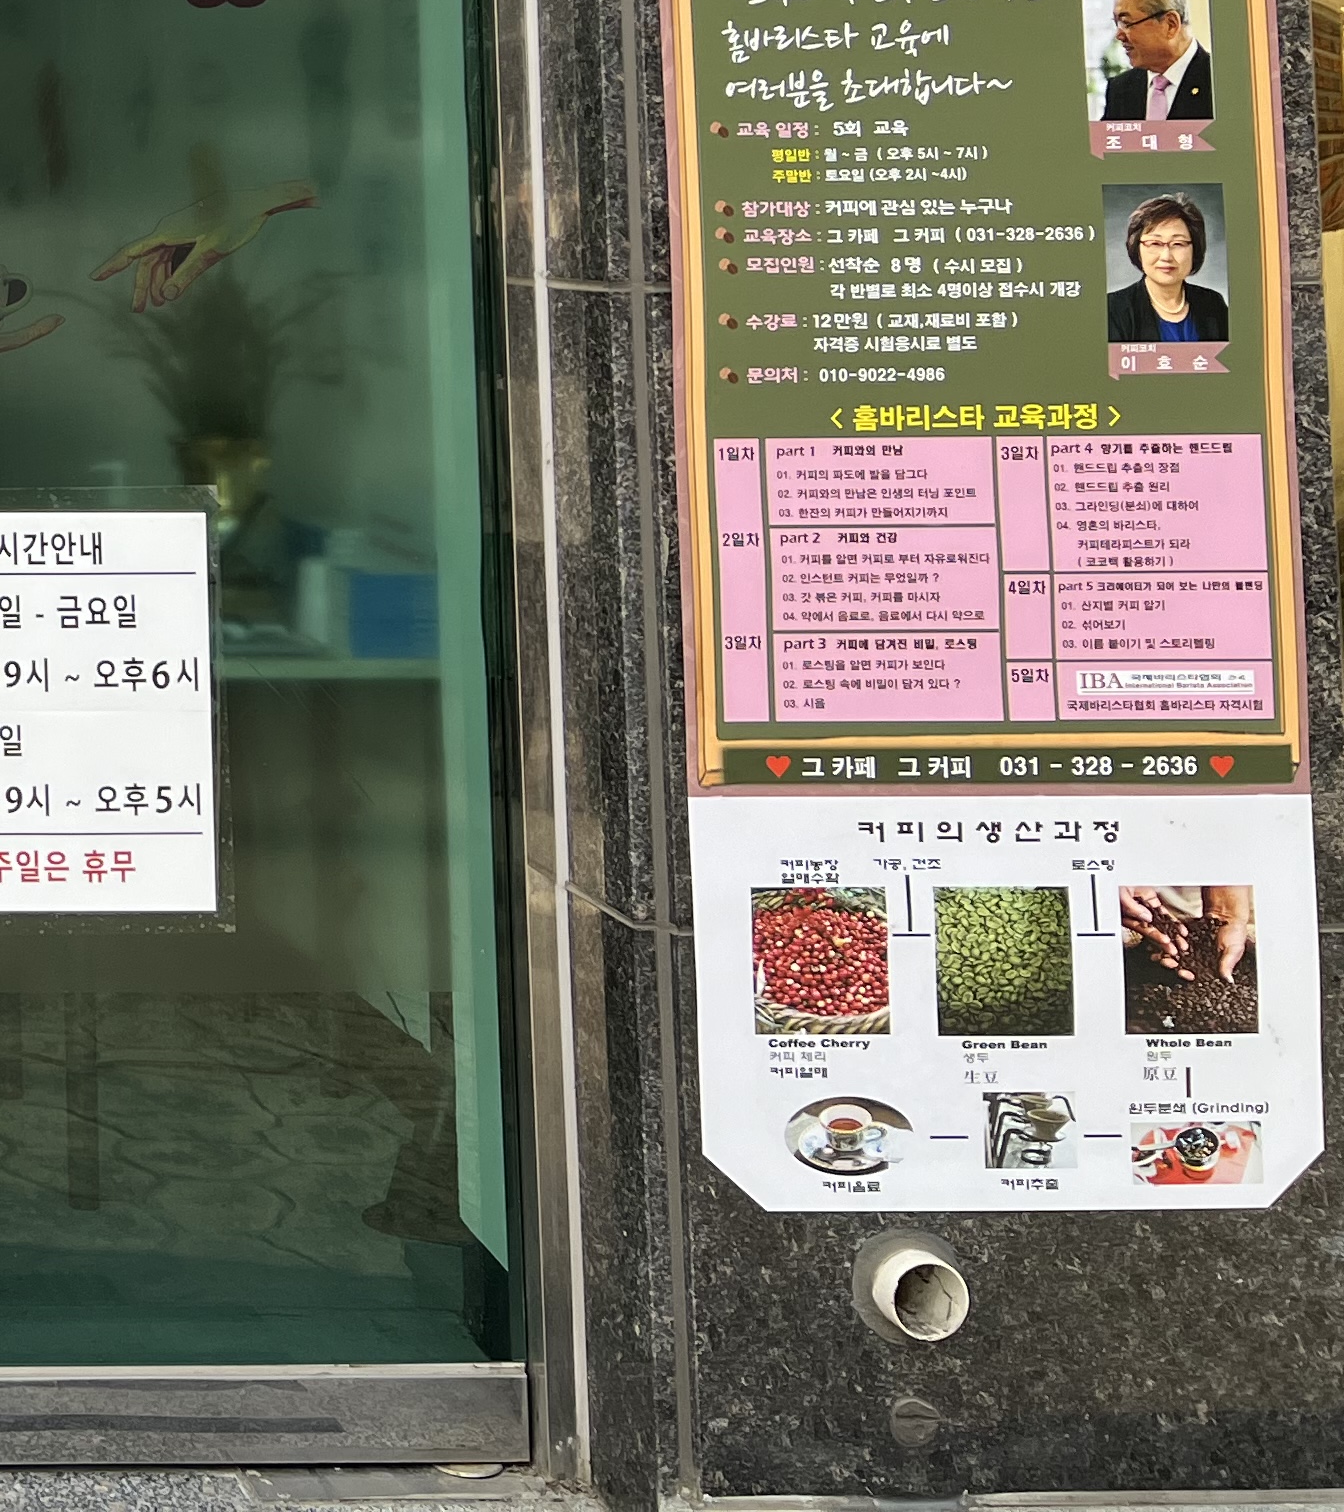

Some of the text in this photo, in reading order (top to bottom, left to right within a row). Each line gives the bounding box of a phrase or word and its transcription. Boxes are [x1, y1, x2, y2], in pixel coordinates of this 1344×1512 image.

[721, 21, 950, 64] 홈바리스타 교육에
[724, 68, 1013, 112] 여러분을 초대합니다~
[741, 197, 1014, 219] 참가대상 커피에 관심 있는 누구나
[742, 225, 1085, 246] 교육장소 그 카페 그 커피 031-328-2636
[746, 365, 946, 386] 문의처 010-9022-4986
[852, 401, 1099, 432] 홈바리스타 교육과정
[718, 446, 755, 462] 1일차
[1000, 445, 1039, 461] 3일차
[722, 532, 759, 547] 2일차
[1008, 579, 1046, 595] 4일차
[57, 594, 138, 629] 금요일
[1118, 600, 1140, 611] 커피
[724, 635, 761, 650] 3일차
[1011, 668, 1049, 683] 5일차
[1079, 672, 1124, 690] IBA
[1067, 699, 1156, 712] 국제바리스타협회
[801, 753, 1198, 779] 그 카페 그 커피 031 328 2636
[82, 850, 137, 884] 휴무
[768, 1038, 871, 1050] Coffee Cherry
[961, 1040, 1049, 1050] Green Bean
[1146, 1038, 1233, 1048] Whole Bean
[1192, 1102, 1269, 1115] (Grinding)
